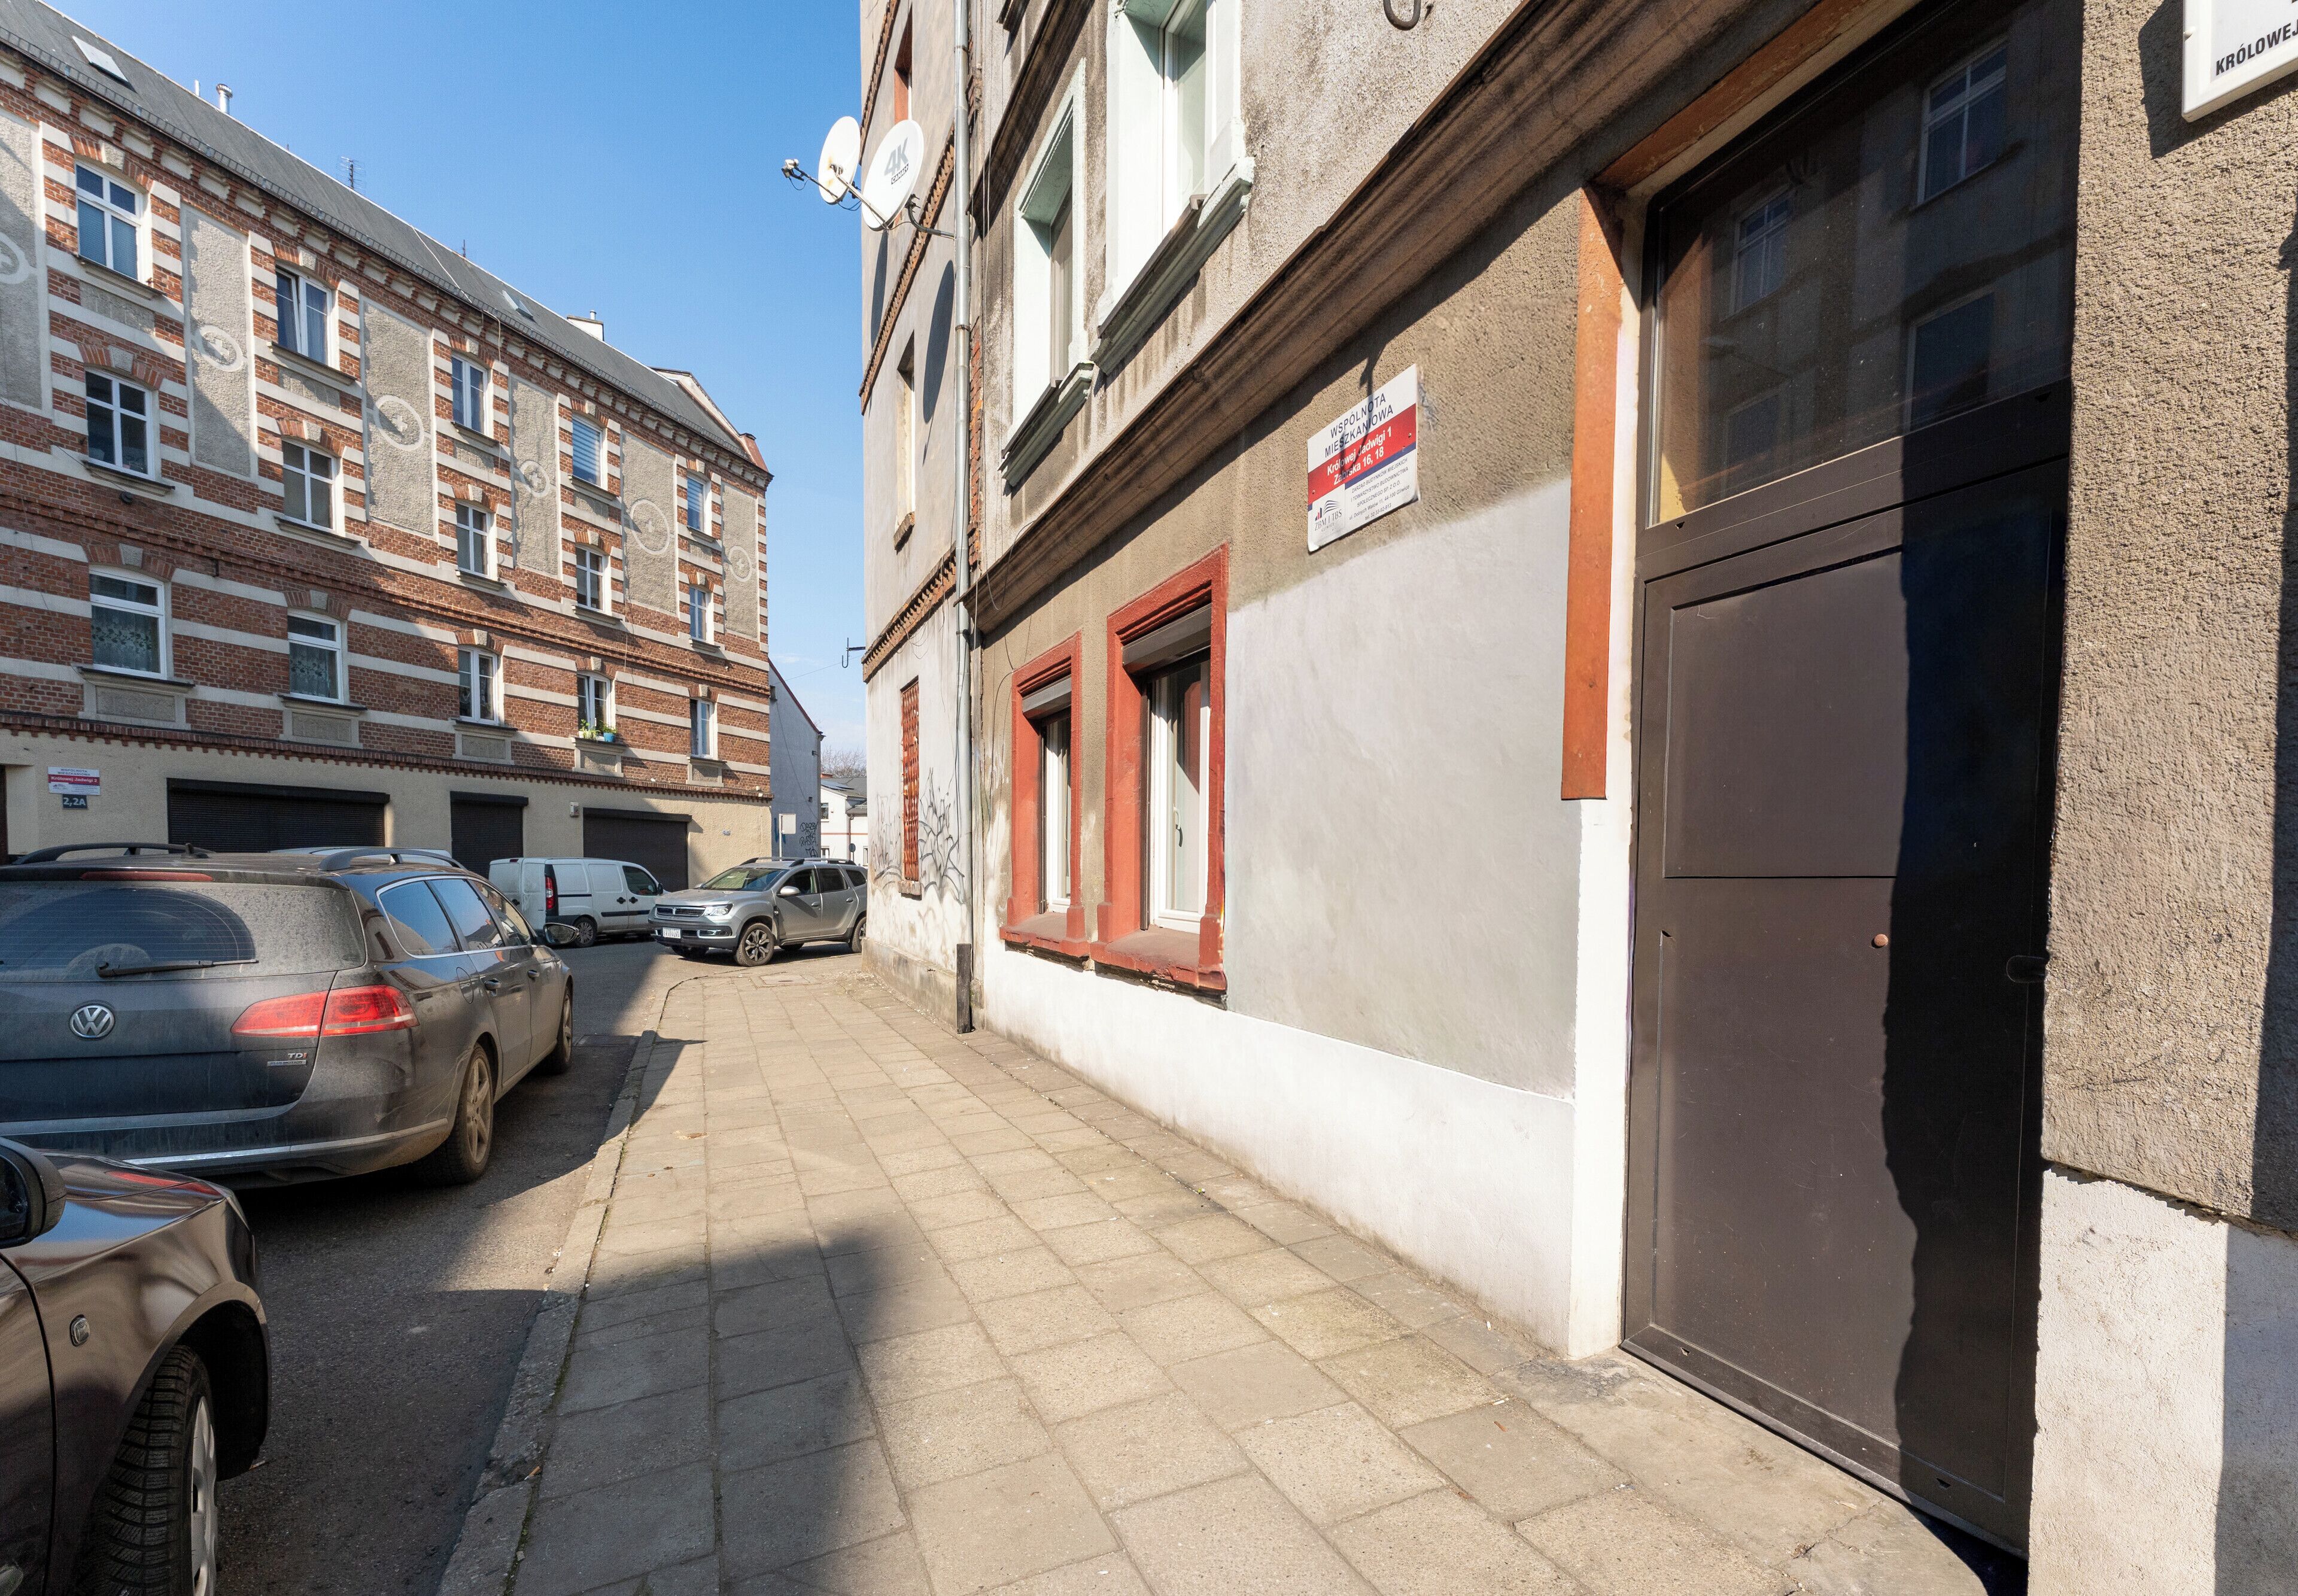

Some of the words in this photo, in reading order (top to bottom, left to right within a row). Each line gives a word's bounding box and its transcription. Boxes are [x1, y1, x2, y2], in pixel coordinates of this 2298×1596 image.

[2216, 19, 2298, 76] KRÓLOWEJ
[884, 137, 908, 176] 4K
[1325, 405, 1393, 458] MIESZKANIOWA
[1330, 393, 1386, 438] WSPÓLNOTA
[1327, 448, 1357, 476] Królowej
[1358, 430, 1385, 456] Jadwigi
[1387, 426, 1391, 437] 1
[1334, 463, 1361, 485] Zabrska
[1363, 454, 1373, 467] 16,
[1375, 446, 1384, 460] 18
[1352, 482, 1366, 493] ZARZĄD
[1366, 469, 1387, 485] BUDYNKÓW
[1387, 457, 1408, 472] MIEJSKICH
[1353, 483, 1379, 501] TOWARZYSTWO
[1379, 466, 1409, 487] BUDOWNICTWA
[1332, 509, 1342, 521] TBS
[63, 797, 86, 807] 2,2A
